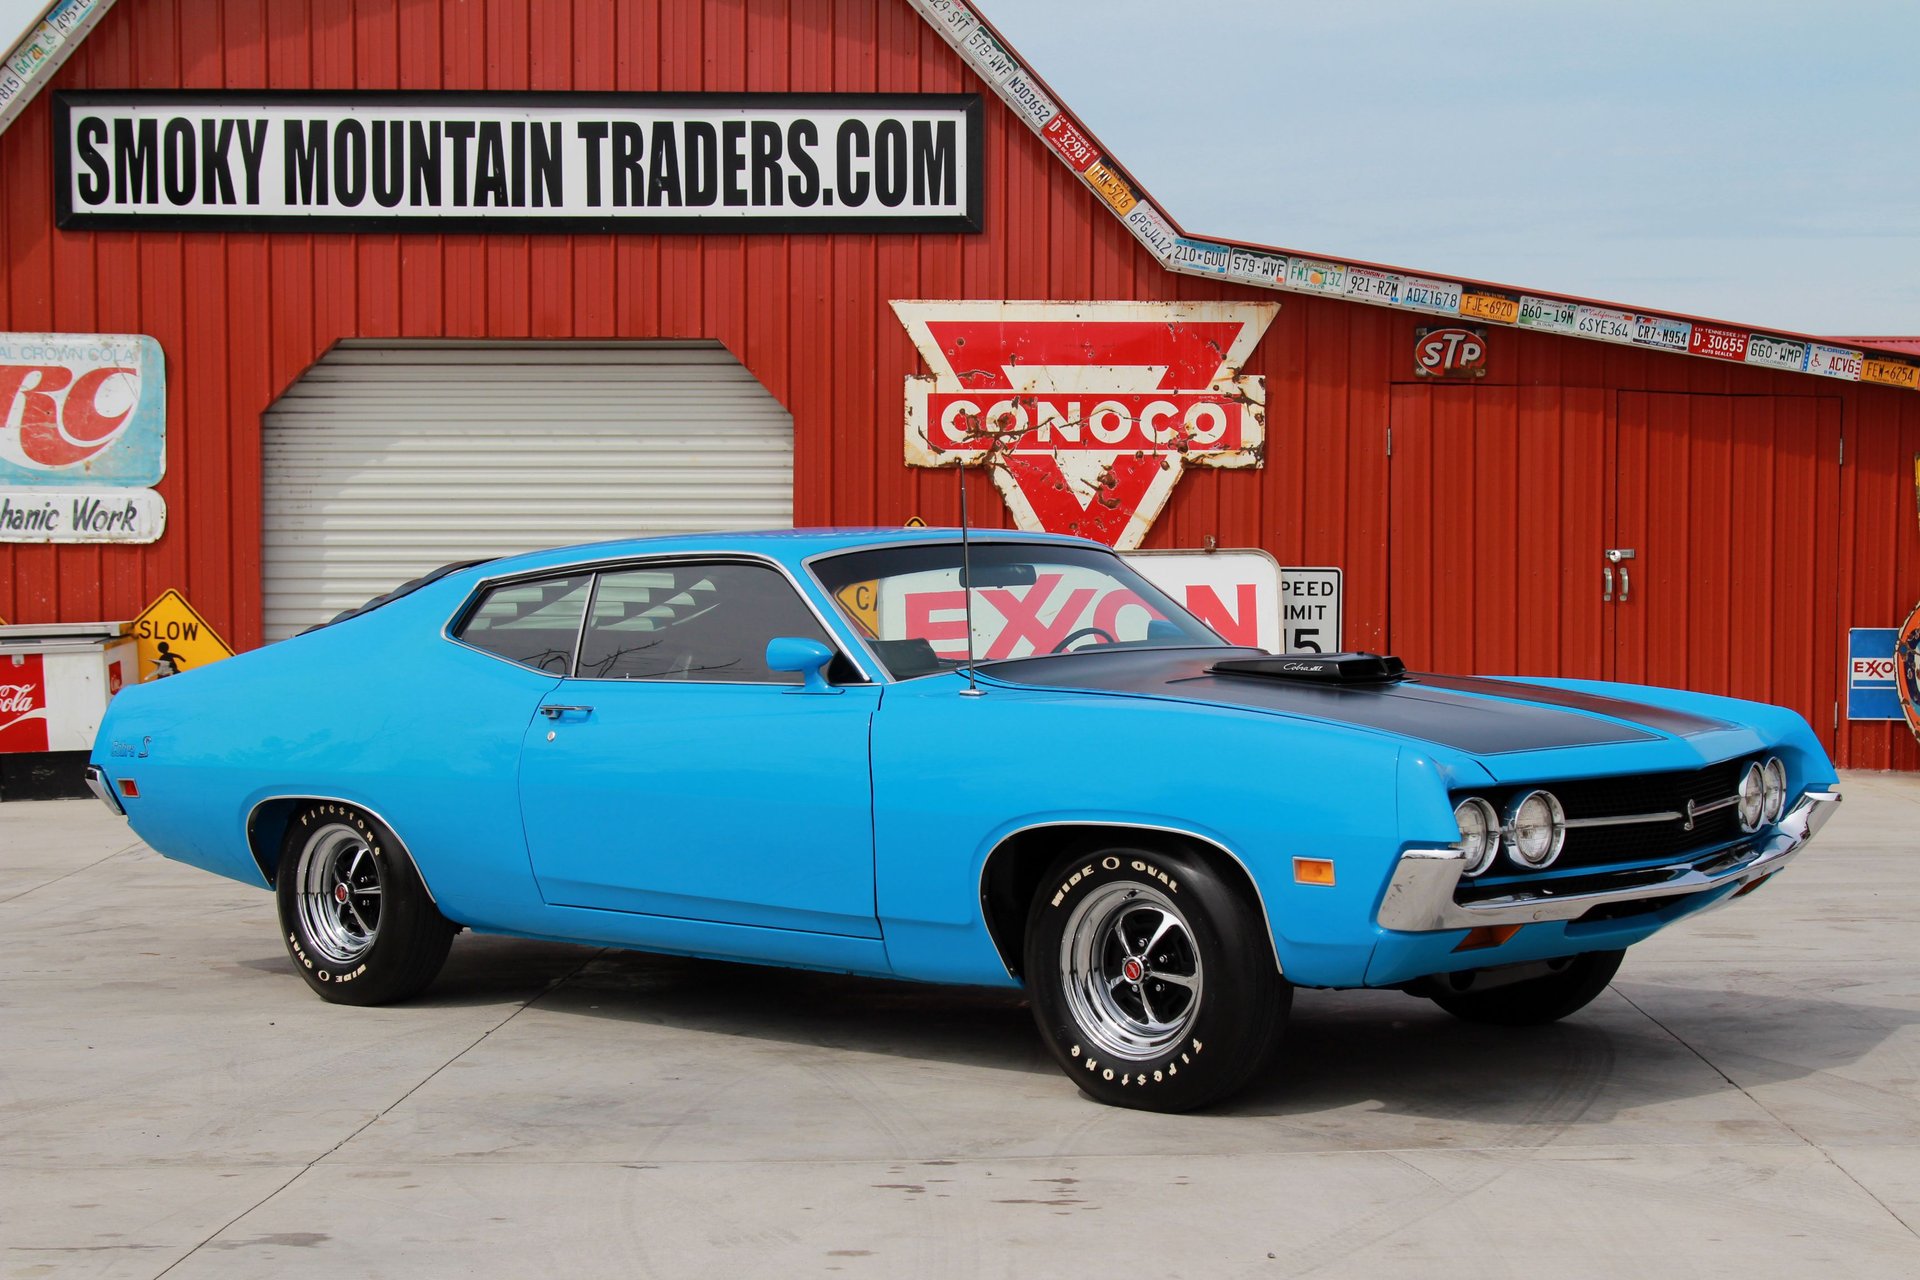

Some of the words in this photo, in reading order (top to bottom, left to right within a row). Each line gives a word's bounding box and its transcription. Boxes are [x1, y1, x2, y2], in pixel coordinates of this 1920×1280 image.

[1006, 75, 1052, 122] N303652
[1065, 122, 1090, 148] TENNESSEE
[77, 116, 268, 206] SMOKY
[284, 118, 563, 207] MOUNTAIN
[578, 119, 956, 207] TRADERS.COM
[1128, 209, 1173, 254] 6PGJ412
[1350, 275, 1398, 297] 921-RZM
[1408, 281, 1439, 289] WASHINGTON
[1406, 286, 1457, 308] ADZ1678
[1588, 309, 1621, 321] California
[1578, 316, 1629, 337] 6SYE364
[1704, 328, 1736, 337] TENNESSEE
[21, 346, 83, 361] CROWN
[88, 347, 135, 362] COLA
[1422, 333, 1482, 369] STP
[1818, 346, 1849, 355] FLORIDA
[1828, 355, 1855, 373] ACV6
[940, 399, 1227, 444] CONOCO
[72, 497, 137, 531] Work
[1282, 581, 1334, 597] PEED
[1284, 604, 1327, 620] IMIT
[139, 621, 199, 641] SLOW
[1854, 659, 1894, 678] EXXO
[1051, 864, 1095, 908] WIDE
[1131, 860, 1179, 894] OVAL
